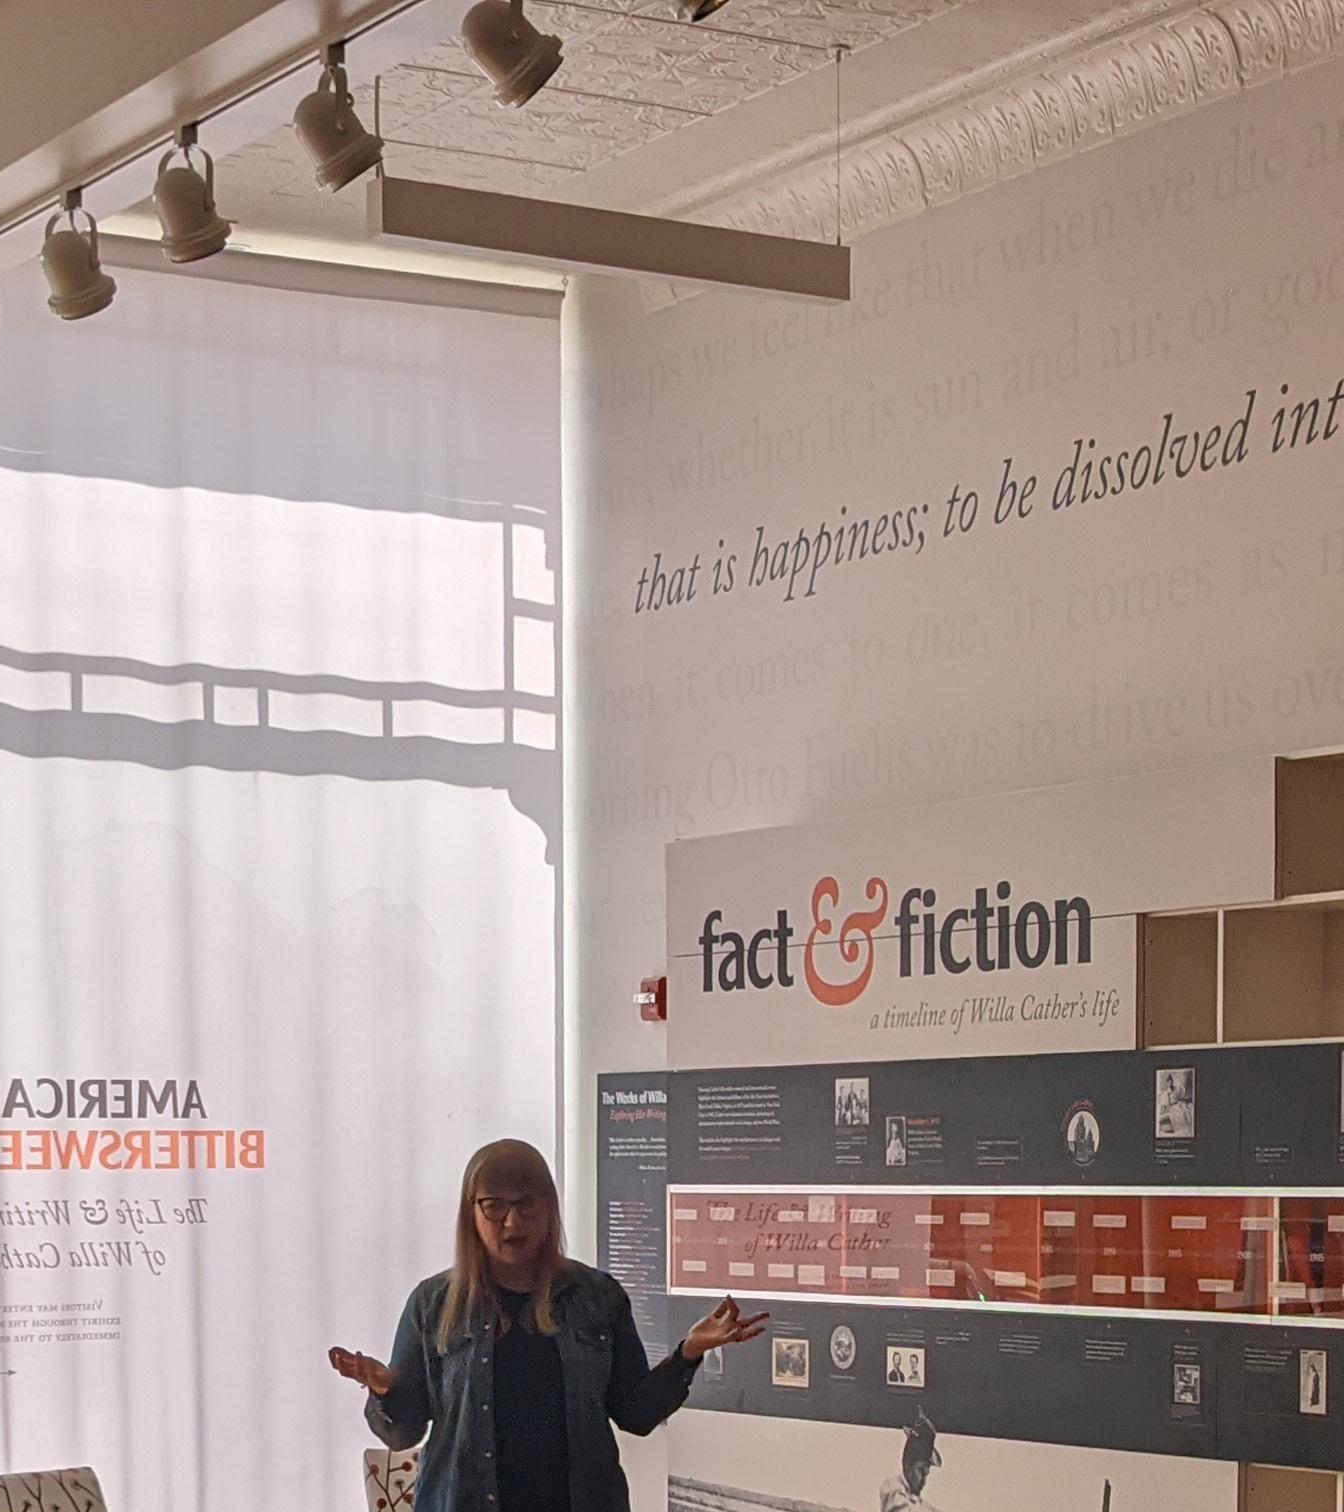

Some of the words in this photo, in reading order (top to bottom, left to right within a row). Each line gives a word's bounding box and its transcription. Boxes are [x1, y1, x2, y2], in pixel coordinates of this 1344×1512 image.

[635, 553, 700, 613] that
[713, 540, 736, 595] is
[749, 504, 928, 602] happiness;
[943, 485, 978, 537] to
[994, 458, 1036, 524] be
[1052, 389, 1256, 510] dissolved
[699, 909, 794, 992] fact
[805, 876, 888, 1007] &
[894, 880, 1093, 979] fiction
[869, 1013, 881, 1030] a
[887, 1003, 945, 1027] timeline
[951, 1000, 969, 1034] of
[972, 997, 1014, 1022] Willa
[1021, 992, 1087, 1020] Cather's
[1093, 990, 1119, 1026] life
